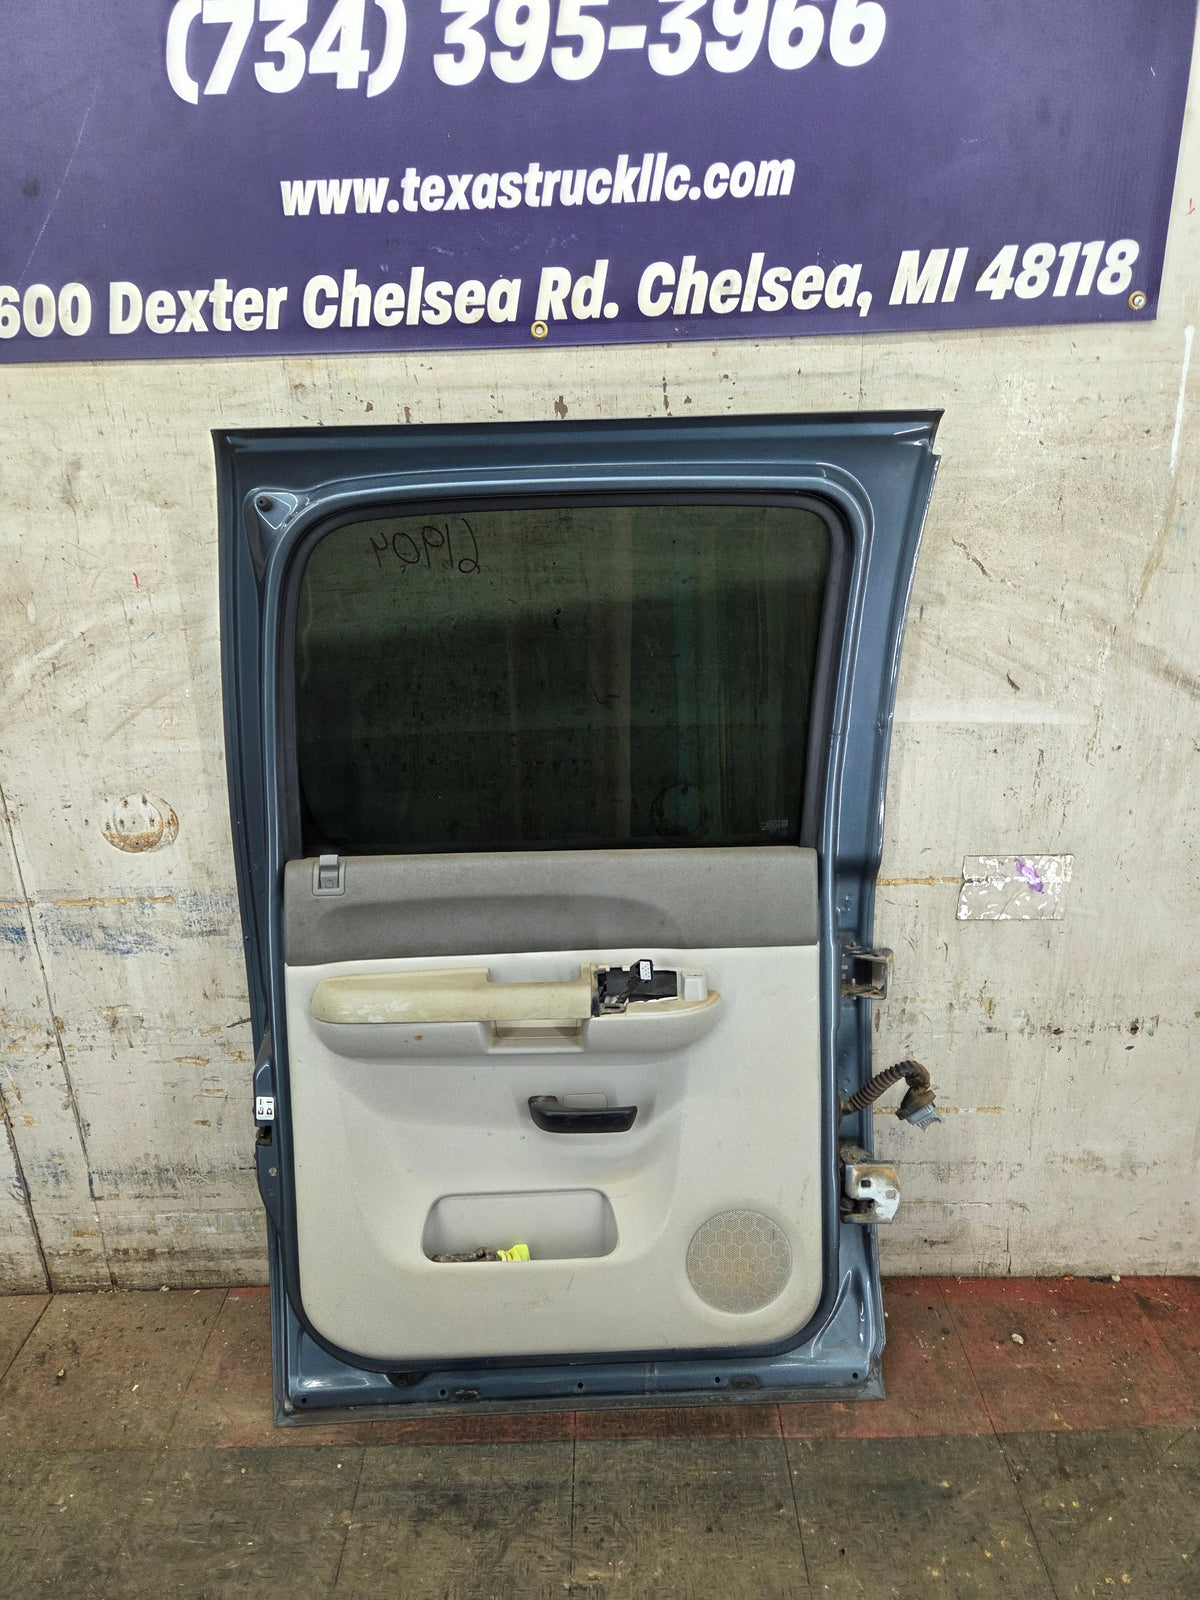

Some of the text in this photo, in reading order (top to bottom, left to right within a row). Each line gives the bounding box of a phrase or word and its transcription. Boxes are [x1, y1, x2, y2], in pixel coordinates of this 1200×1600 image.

[165, 0, 887, 105] (734) 395-3966
[280, 152, 796, 217] www.texastruckllc.com
[109, 278, 289, 335] Dexter
[303, 266, 522, 328] Chelsea
[534, 258, 619, 320] Rd.
[636, 252, 873, 317] Chelsea,
[888, 247, 970, 306] MI
[975, 239, 1141, 301] 48118
